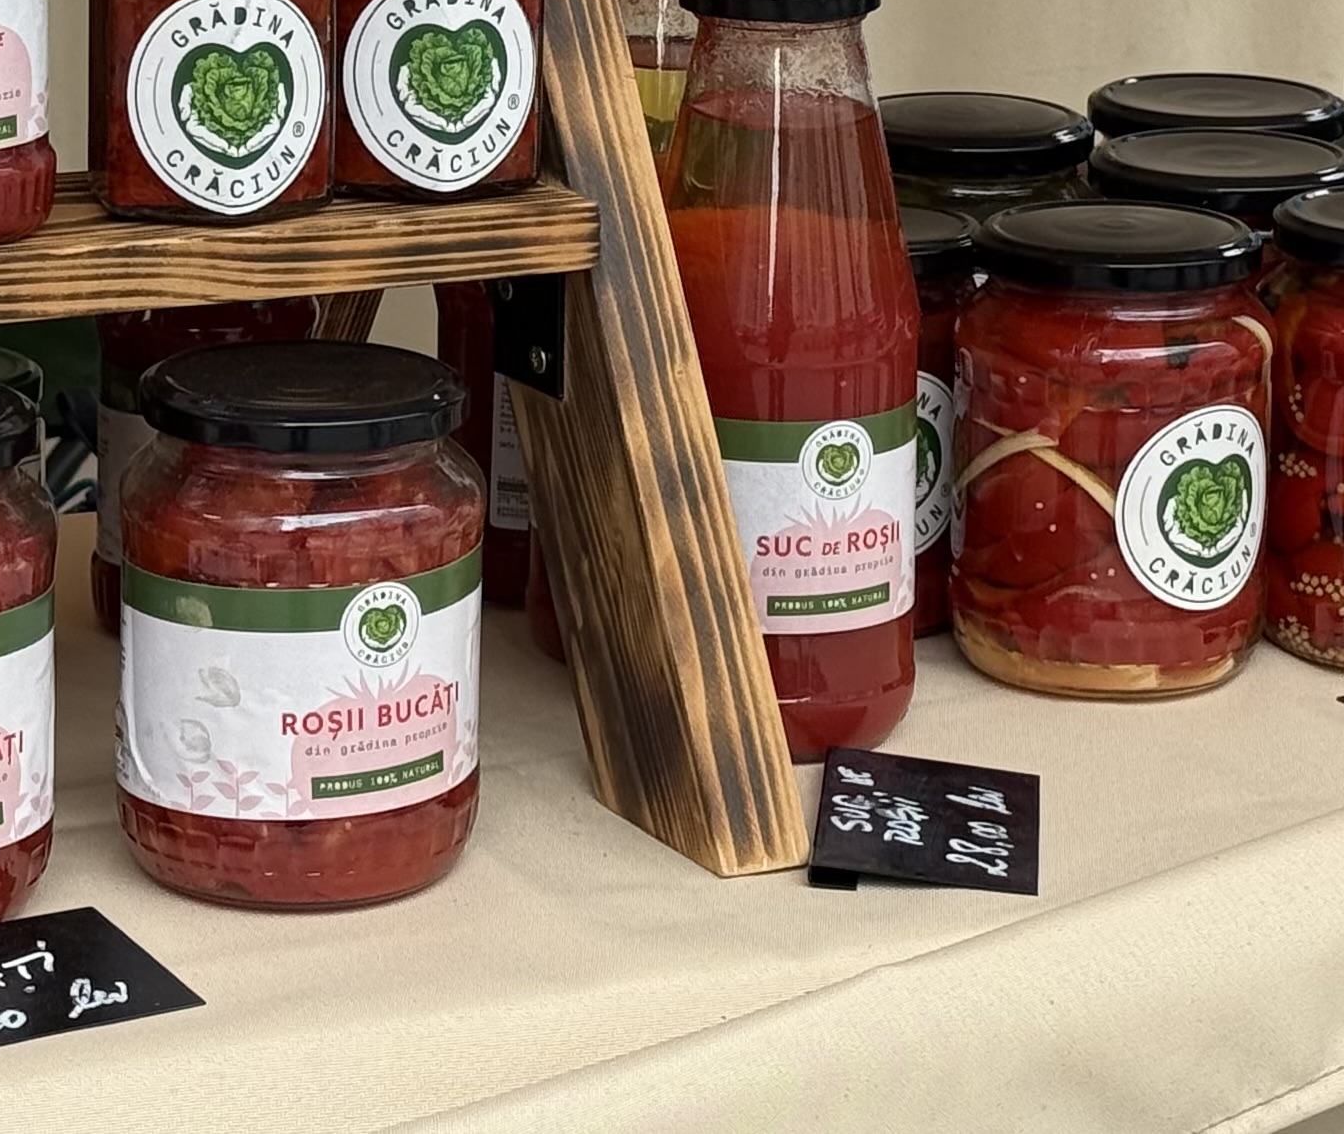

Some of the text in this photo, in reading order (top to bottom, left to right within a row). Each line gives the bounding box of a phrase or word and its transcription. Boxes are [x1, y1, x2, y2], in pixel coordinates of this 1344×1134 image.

[170, 1, 294, 50] GRĂDINA
[386, 118, 511, 174] CRĂCIUN
[166, 146, 297, 199] CRĂCIUN
[1158, 420, 1255, 467] GRĂDINA
[756, 535, 812, 558] SUC
[820, 540, 841, 556] DE
[846, 519, 901, 554] ROȘII
[762, 554, 894, 580] din grădina proprie
[1148, 547, 1252, 596] CRĂCIUN
[820, 597, 848, 609] 100%
[281, 680, 460, 742] ROȘII BUCĂȚI
[304, 721, 449, 758] din grădina proprie
[318, 777, 364, 792] PRODUS
[370, 772, 399, 788] 100%
